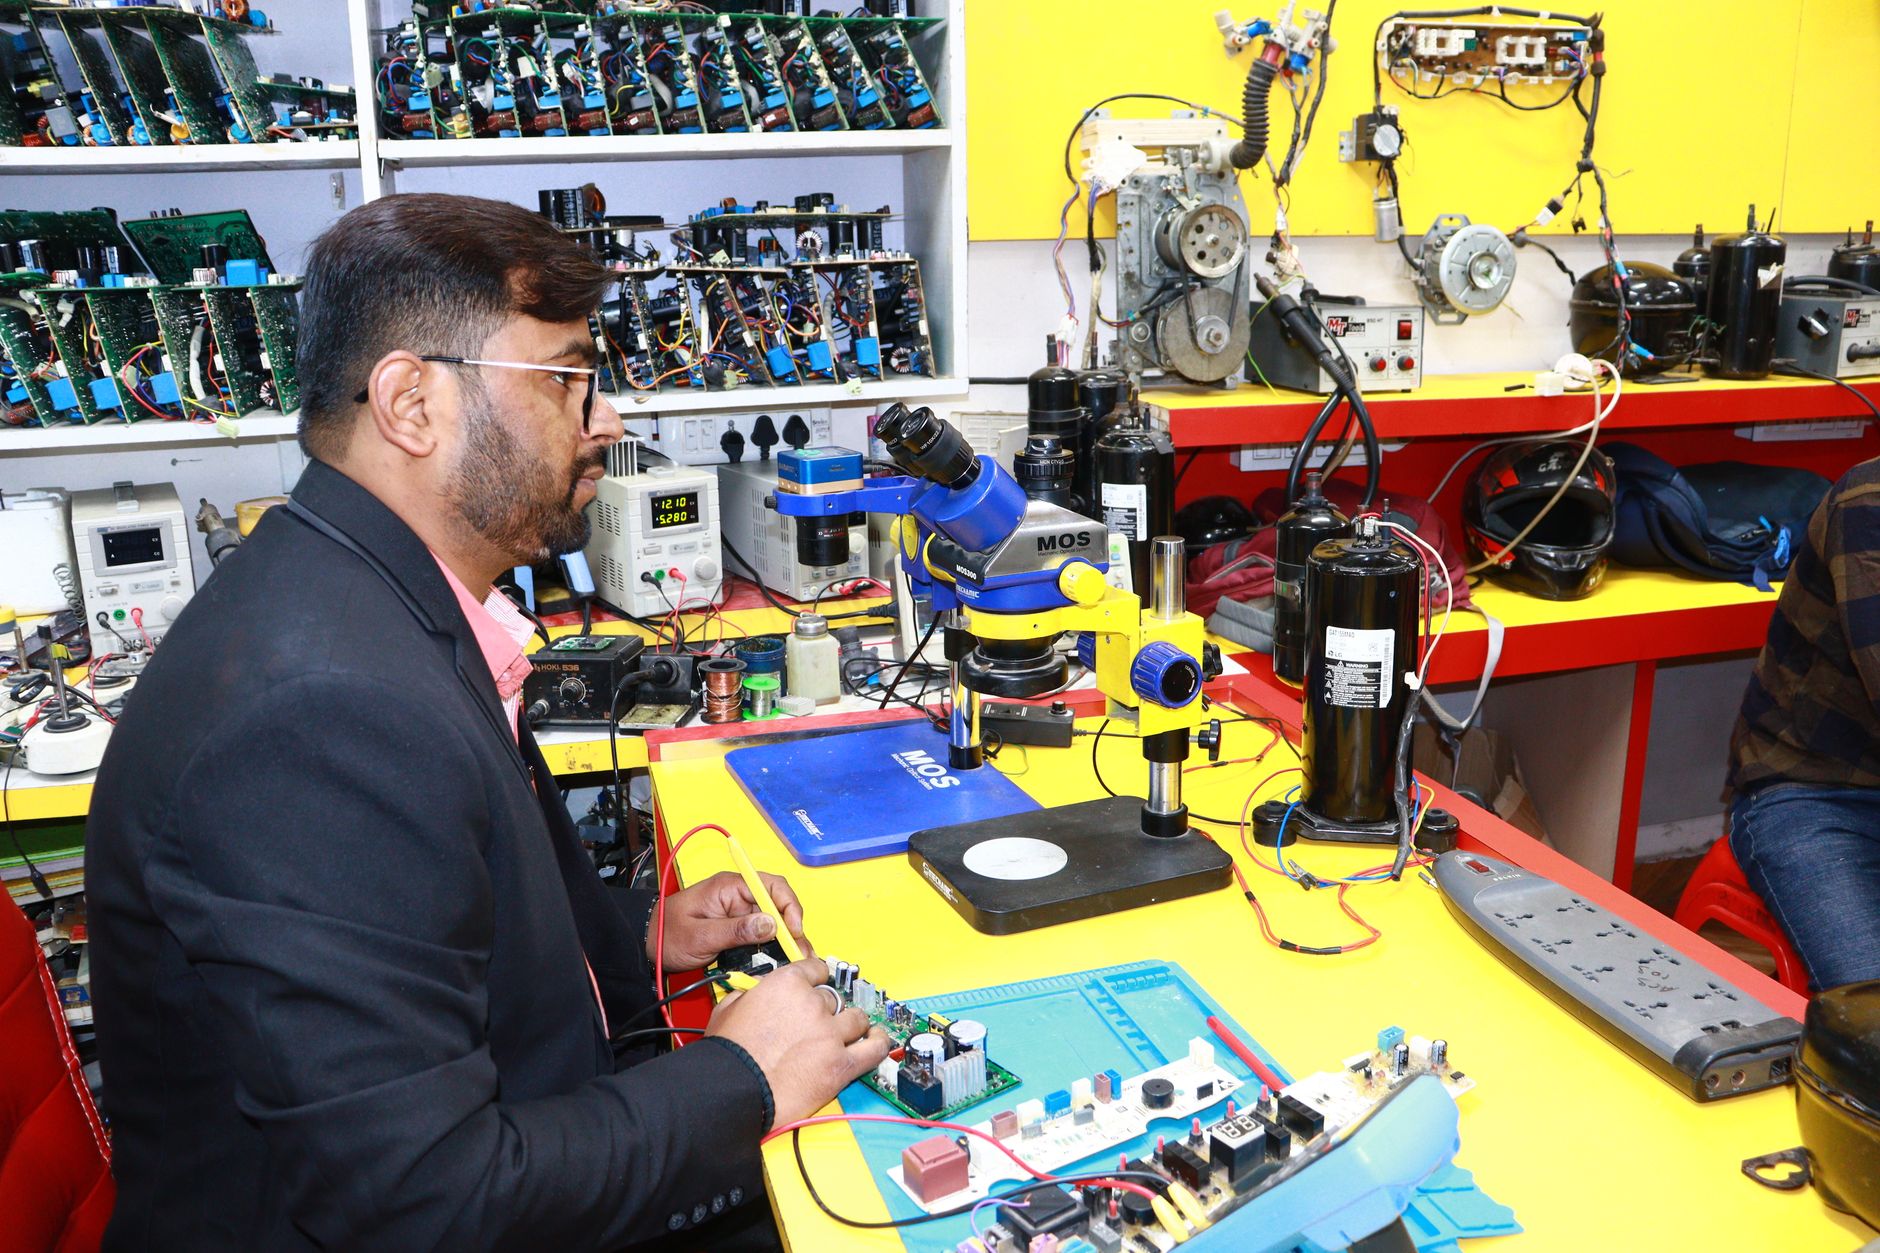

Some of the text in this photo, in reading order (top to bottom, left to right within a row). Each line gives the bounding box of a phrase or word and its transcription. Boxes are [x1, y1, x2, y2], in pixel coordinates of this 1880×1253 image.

[1037, 531, 1090, 551] MOS
[956, 564, 977, 580] MOS300
[900, 749, 960, 789] MOS
